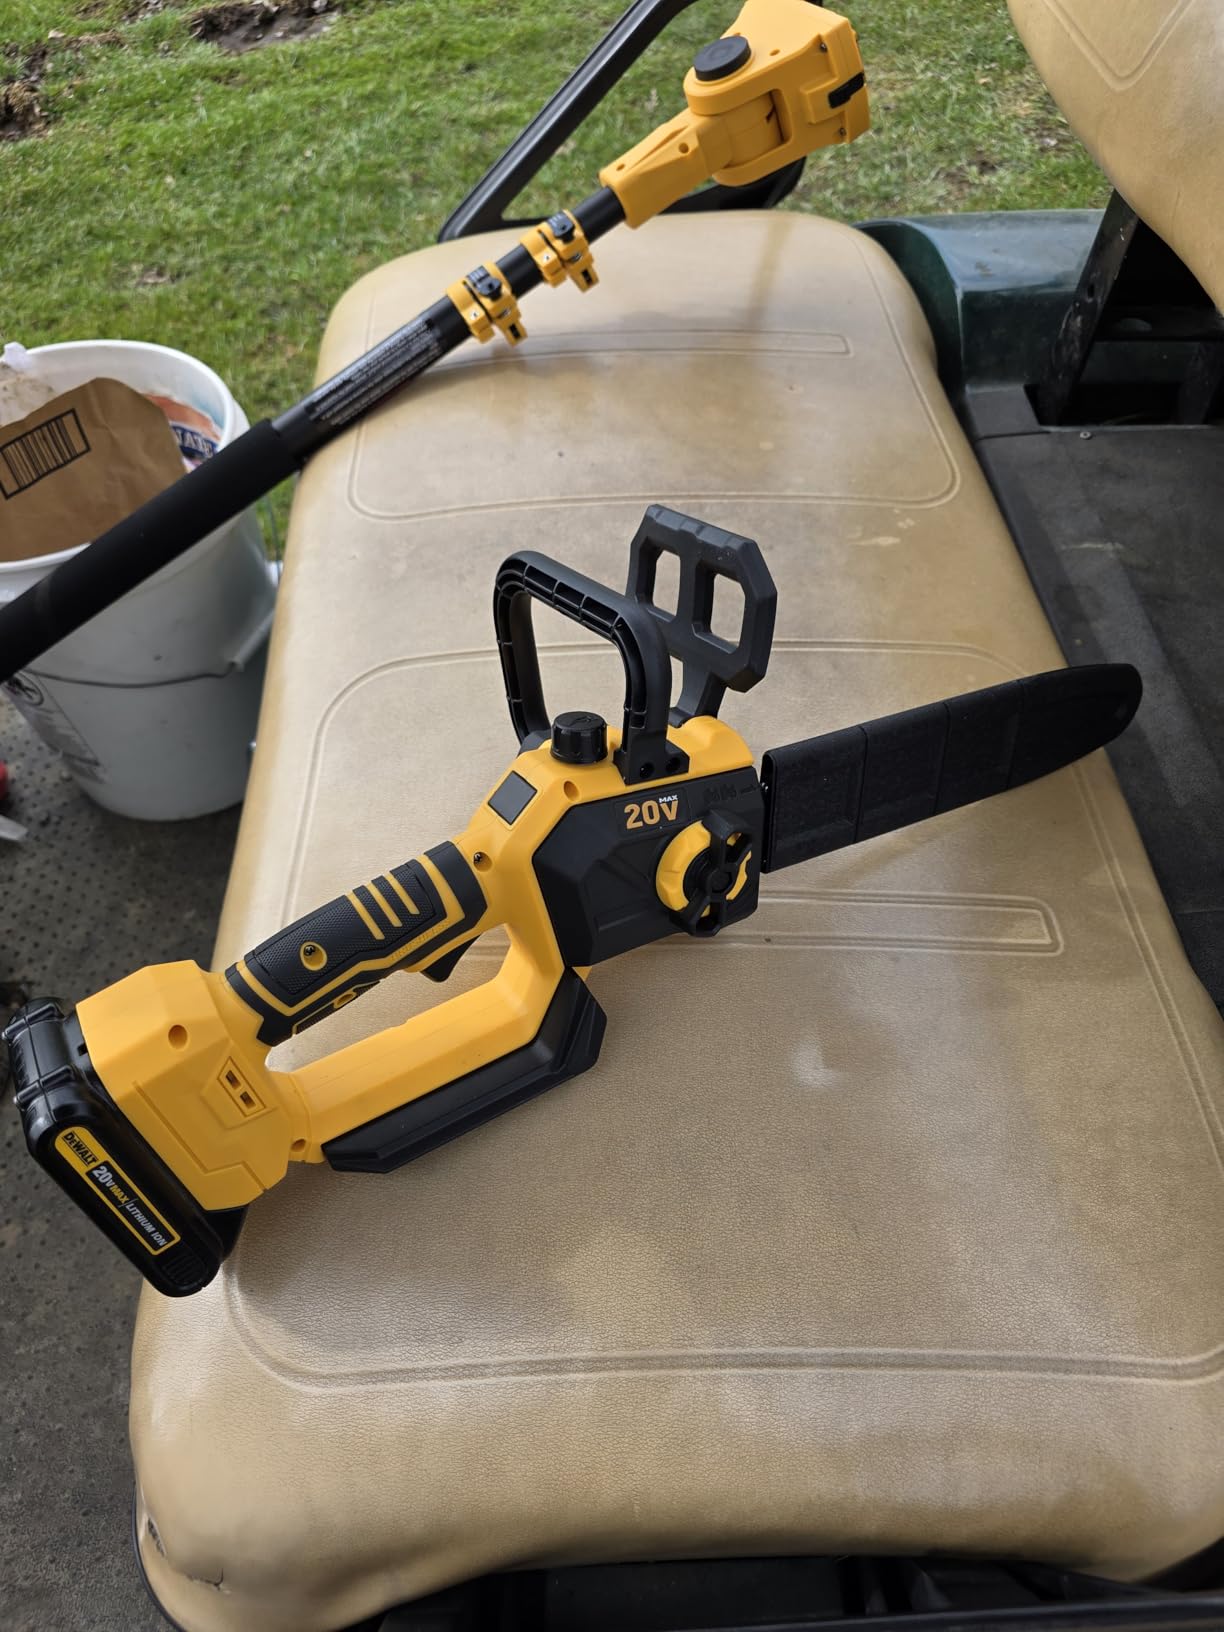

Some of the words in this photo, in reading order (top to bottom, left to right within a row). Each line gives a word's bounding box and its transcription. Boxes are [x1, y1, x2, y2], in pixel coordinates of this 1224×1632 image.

[659, 794, 678, 804] MAX
[624, 800, 679, 829] 20V
[125, 1203, 156, 1233] LITHIUM
[151, 1231, 167, 1246] ION
